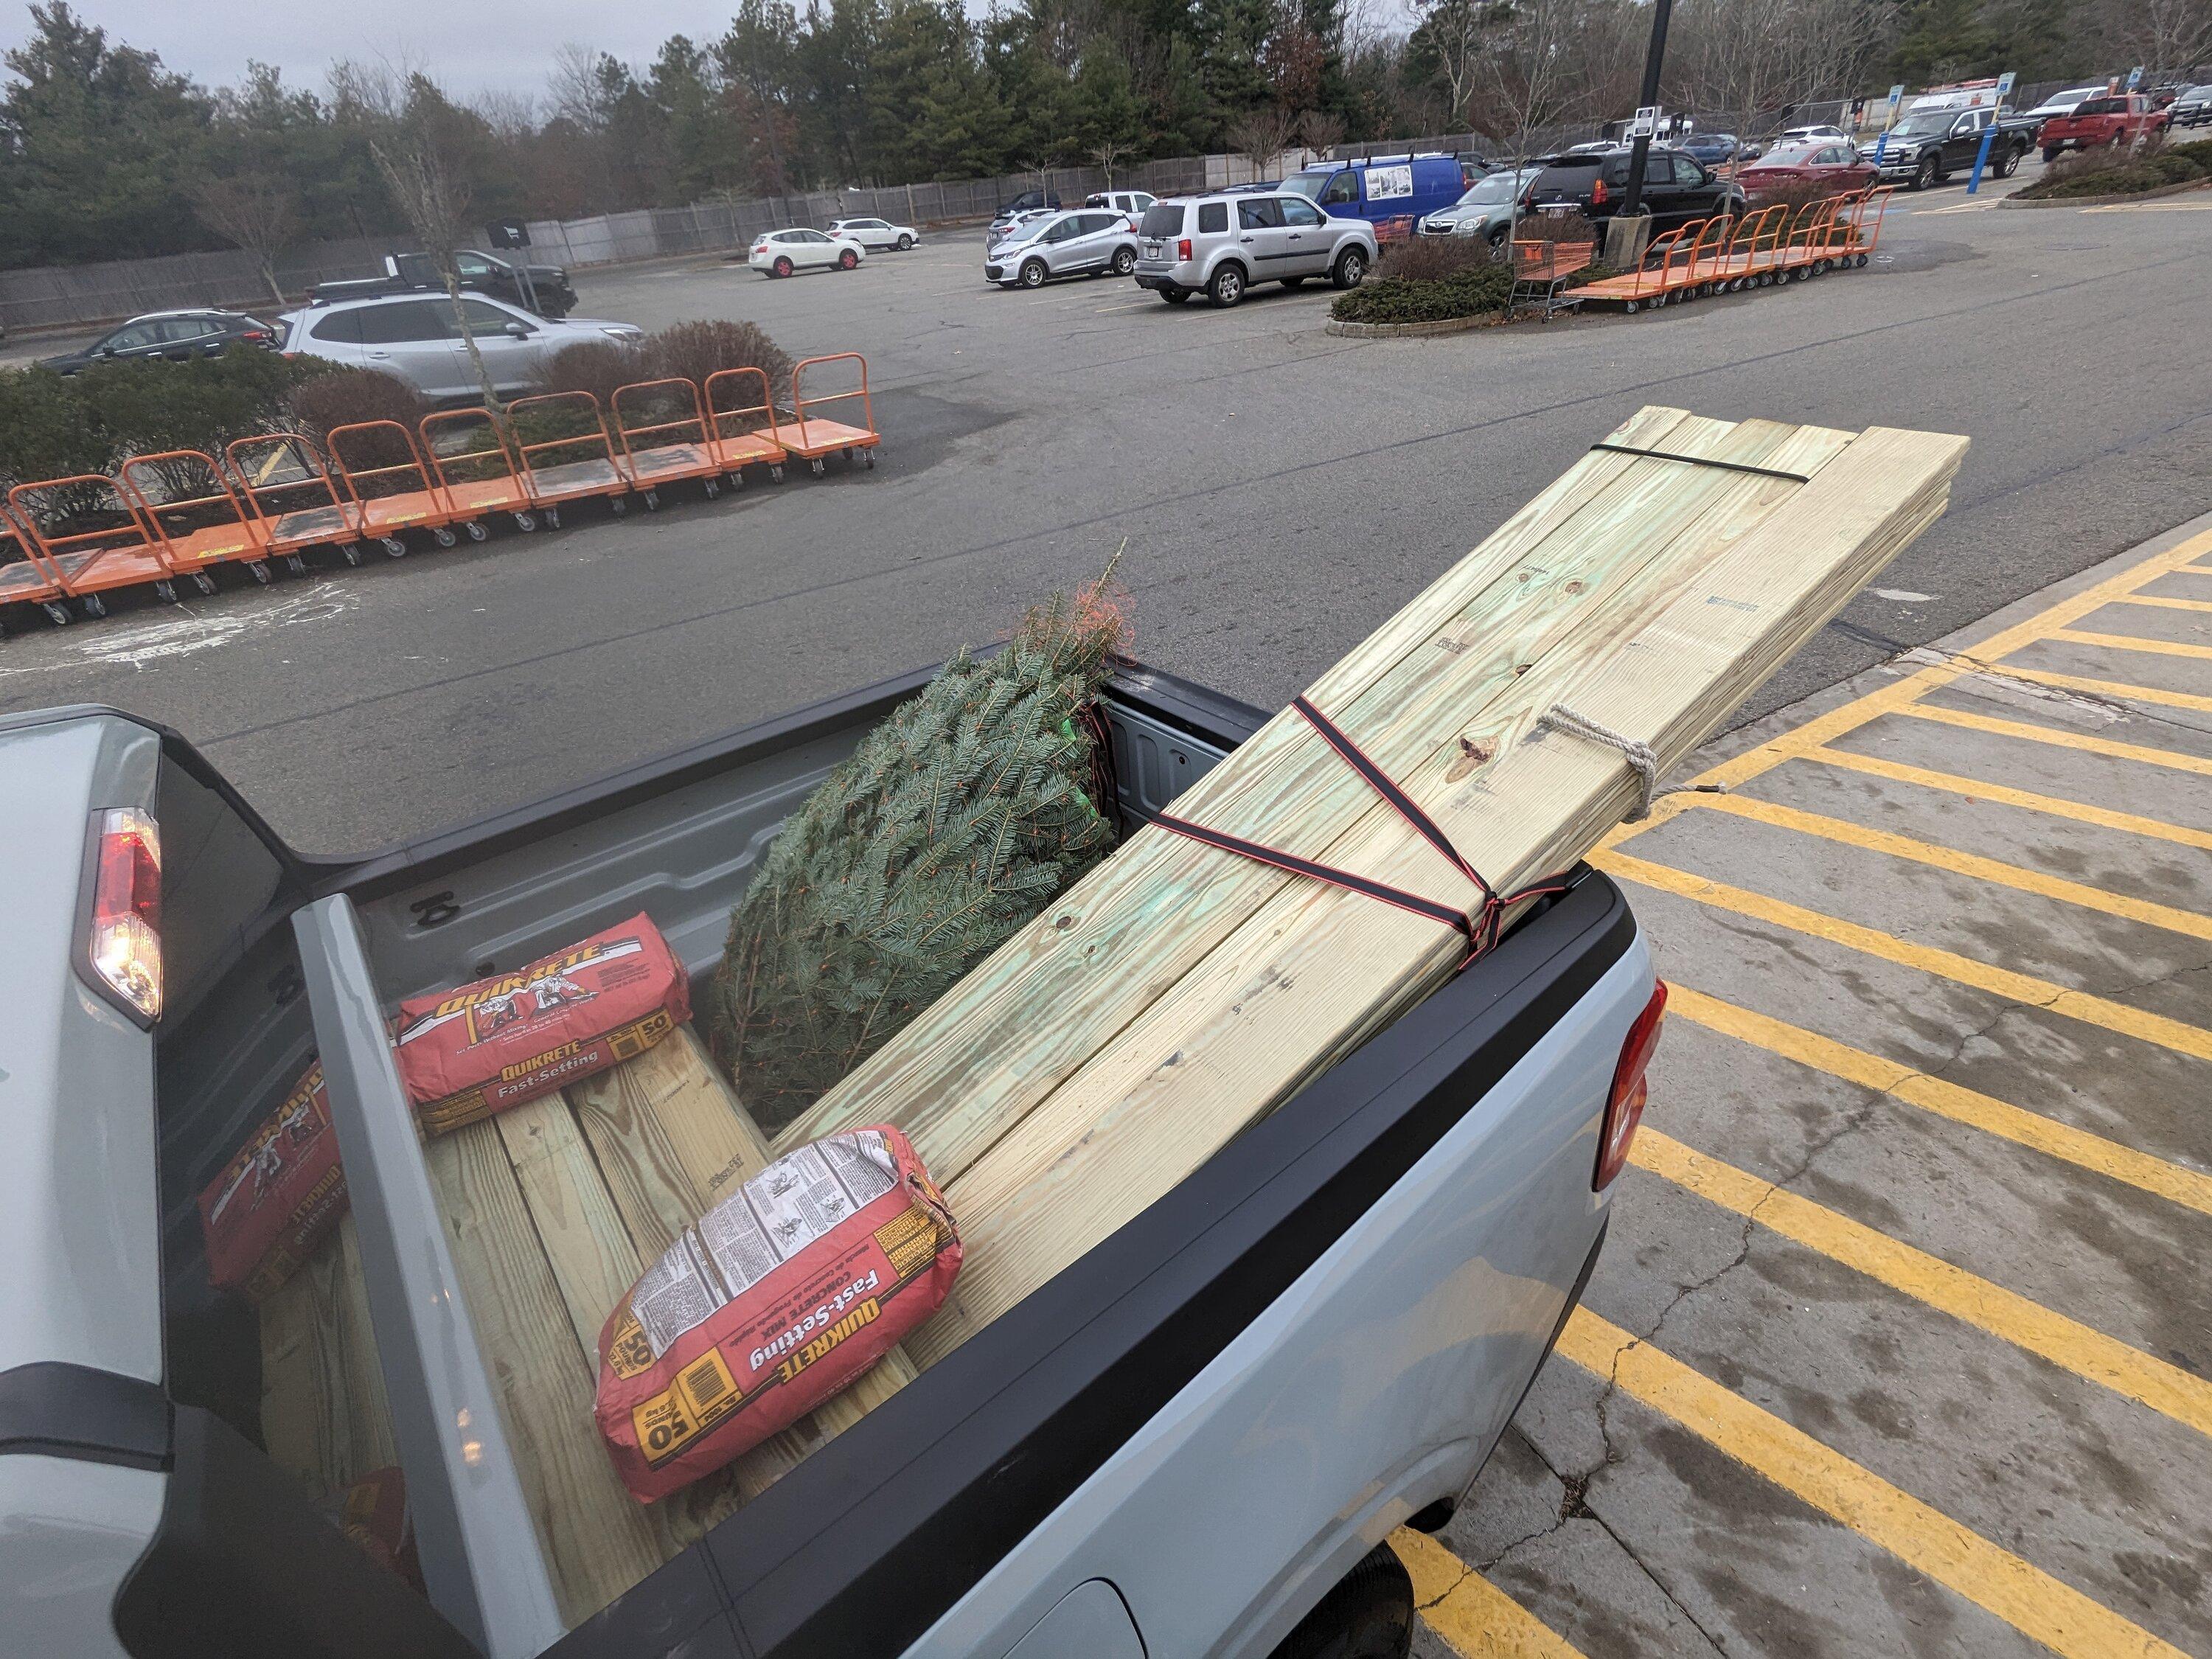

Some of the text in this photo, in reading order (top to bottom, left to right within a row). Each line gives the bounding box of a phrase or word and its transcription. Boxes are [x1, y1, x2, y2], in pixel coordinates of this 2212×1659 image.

[435, 944, 600, 1017] QUIKRETE
[642, 1015, 667, 1035] 50
[498, 1051, 598, 1099] Fast-Setting
[501, 1040, 582, 1082] QUIKRETE
[749, 1269, 880, 1371] Fast-Setting
[762, 1270, 852, 1341] CONCRETE MIX
[623, 1330, 651, 1366] 50
[778, 1297, 880, 1383] QUIKRETE
[648, 1411, 689, 1450] 50
